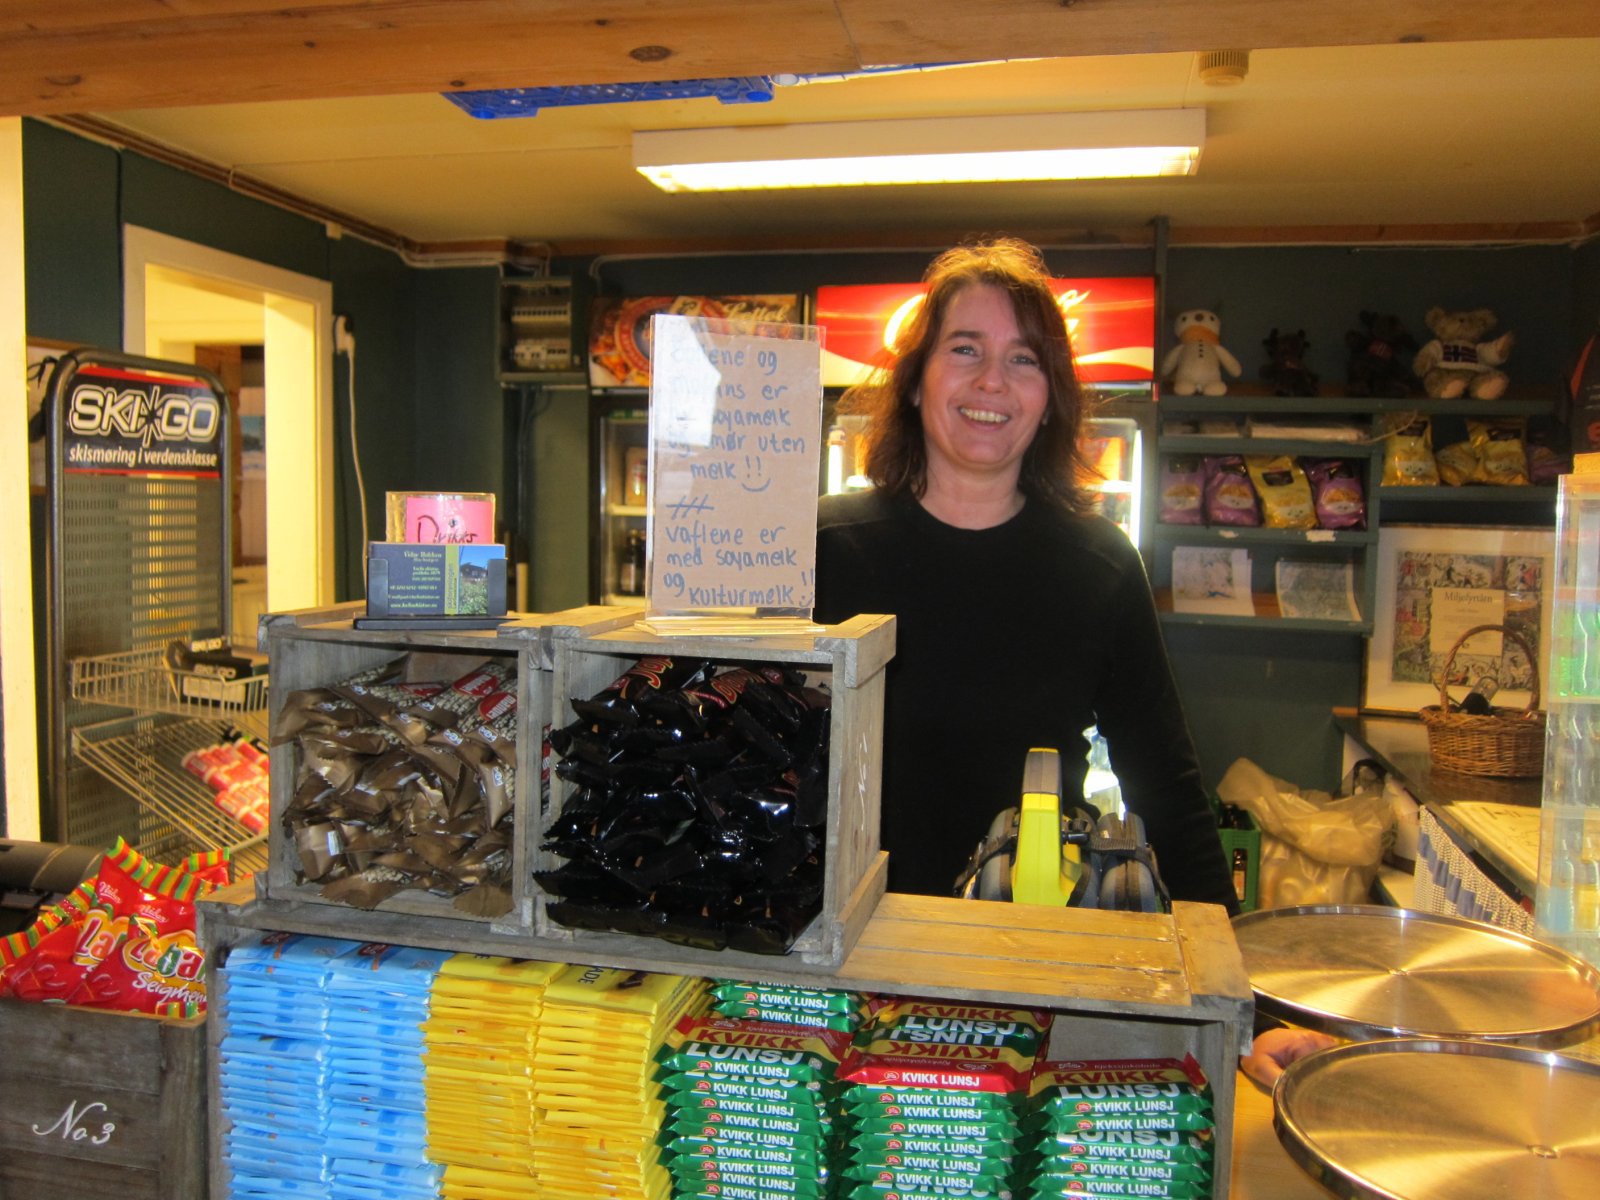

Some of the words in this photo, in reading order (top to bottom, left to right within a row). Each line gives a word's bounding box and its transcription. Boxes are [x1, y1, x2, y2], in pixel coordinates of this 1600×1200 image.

[757, 351, 778, 376] og
[761, 384, 789, 400] er
[713, 407, 791, 431] oyamelk
[704, 432, 746, 451] mør
[758, 433, 806, 453] uten
[69, 443, 136, 468] skismøring
[142, 449, 217, 467] verdensklasse
[690, 461, 736, 480] melk
[760, 526, 786, 545] er
[667, 547, 703, 567] med
[716, 547, 797, 571] soyamelk
[663, 572, 685, 598] og
[760, 993, 792, 1006] KVIKK
[794, 996, 829, 1009] LUNSJ
[762, 1010, 793, 1023] KVIKK
[795, 1014, 829, 1028] LUNSJ
[910, 1004, 1015, 1022] KVIKK
[905, 1016, 1017, 1035] LUNSJ
[696, 1029, 807, 1050] KVIKK
[889, 1029, 1005, 1046] LUNSJ
[686, 1043, 804, 1066] LUNSJ
[889, 1041, 1000, 1060] KVIKK
[714, 1062, 749, 1075] KVIKK
[752, 1065, 790, 1078] LUNSJ
[1053, 1070, 1172, 1084] KVIKK
[902, 1072, 938, 1085] KVIKK
[941, 1074, 980, 1087] LUNSJ
[713, 1083, 748, 1096] KVIKK
[751, 1087, 788, 1100] LUNSJ
[1058, 1083, 1181, 1100] LUNSJ
[719, 1100, 754, 1113] KVIKK
[757, 1105, 794, 1117] LUNSJ
[897, 1094, 933, 1106] KVIKK
[936, 1095, 976, 1107] LUNSJ
[1094, 1101, 1131, 1112] KVIKK
[1135, 1100, 1174, 1112] LUNSJ
[904, 1106, 940, 1118] KVIKK
[943, 1107, 982, 1119] LUNSJ
[725, 1115, 760, 1128] KVIKK
[762, 1119, 799, 1132] LUNSJ
[908, 1123, 944, 1135] KVIKK
[947, 1124, 986, 1136] LUNSJ
[1095, 1119, 1133, 1130] KVIKK
[1136, 1118, 1175, 1130] LUNSJ
[92, 1122, 116, 1145] 3
[719, 1129, 754, 1142] KVIKK
[757, 1133, 794, 1147] LUNSJ
[717, 1146, 752, 1159] KVIKK
[755, 1150, 792, 1163] LUNSJ
[905, 1141, 941, 1153] KVIKK
[944, 1143, 983, 1155] LUNSJ
[1088, 1146, 1126, 1158] KVIKK
[1130, 1148, 1171, 1160] LUNSJ
[719, 1162, 755, 1174] KVIKK
[757, 1165, 795, 1177] LUNSJ
[904, 1157, 940, 1169] KVIKK
[942, 1159, 981, 1172] LUNSJ
[1090, 1164, 1128, 1176] KVIKK
[1131, 1166, 1172, 1179] LUNSJ
[722, 1173, 756, 1186] KVIKK
[759, 1177, 796, 1191] LUNSJ
[896, 1173, 932, 1185] KVIKK
[935, 1175, 974, 1189] LUNSJ
[1086, 1182, 1124, 1194] KVIKK
[1127, 1184, 1168, 1196] LUNSJ
[722, 1186, 756, 1199] KVIKK
